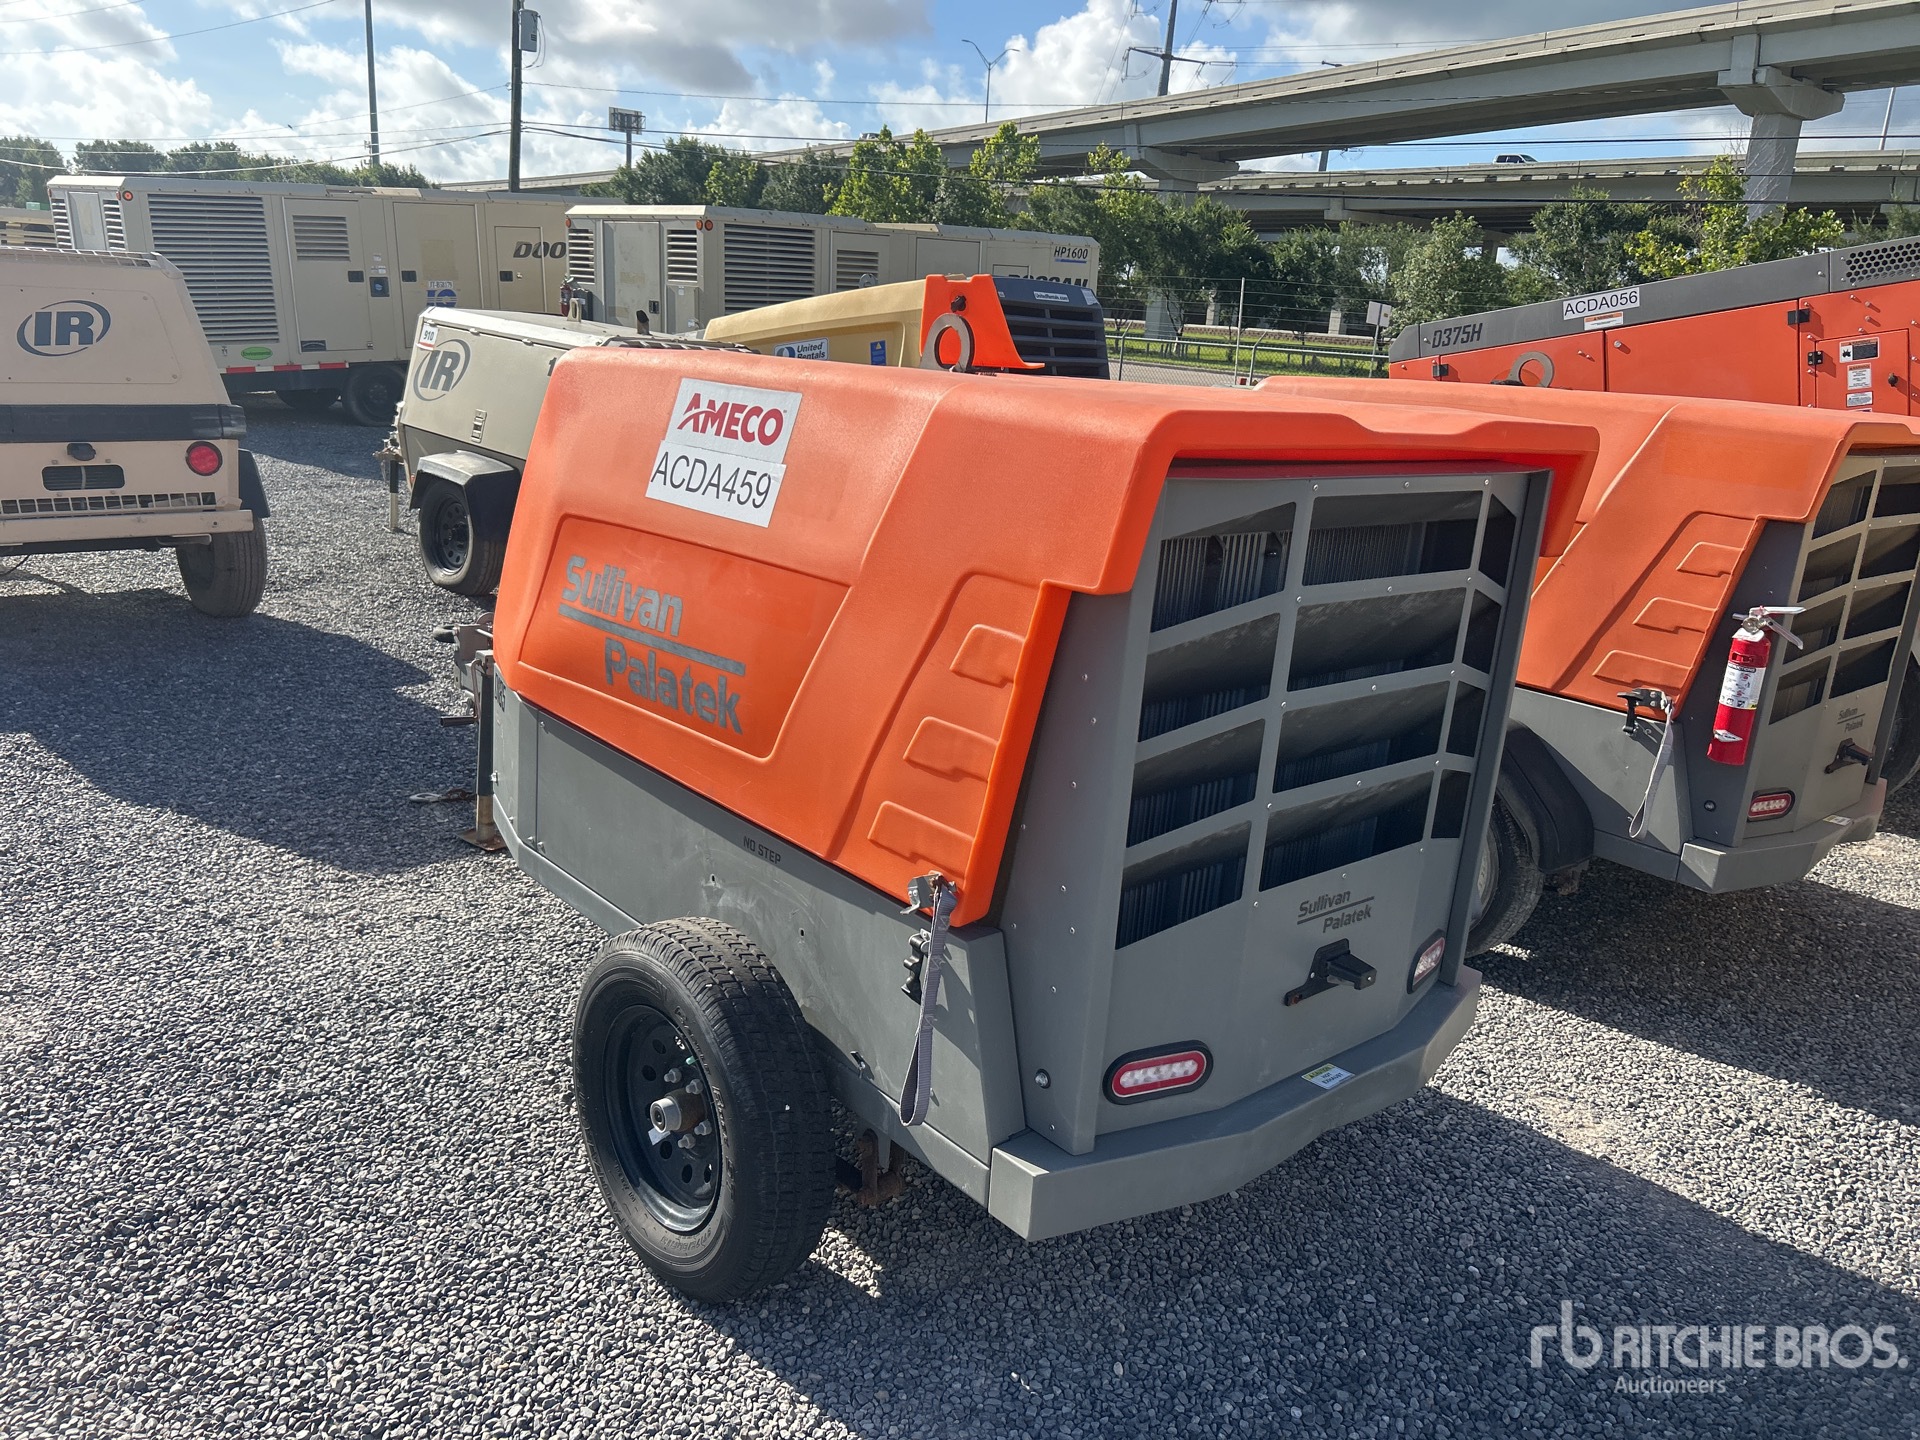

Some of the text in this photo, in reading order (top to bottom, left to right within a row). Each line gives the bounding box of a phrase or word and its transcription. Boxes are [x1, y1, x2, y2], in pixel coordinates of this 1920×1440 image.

[1054, 246, 1088, 259] HP1600
[1564, 291, 1638, 316] ACDA056
[33, 310, 94, 346] IR
[423, 330, 435, 341] 910
[1432, 323, 1483, 348] D375H
[797, 342, 823, 353] United
[419, 350, 461, 392] IR
[677, 393, 784, 446] AMECO
[650, 451, 772, 508] ACDA459
[562, 555, 683, 637] Sullivan
[604, 638, 743, 735] Palatek
[743, 835, 781, 864] NO STEP
[1298, 890, 1351, 918] Sullivan
[1322, 904, 1372, 933] Palatek
